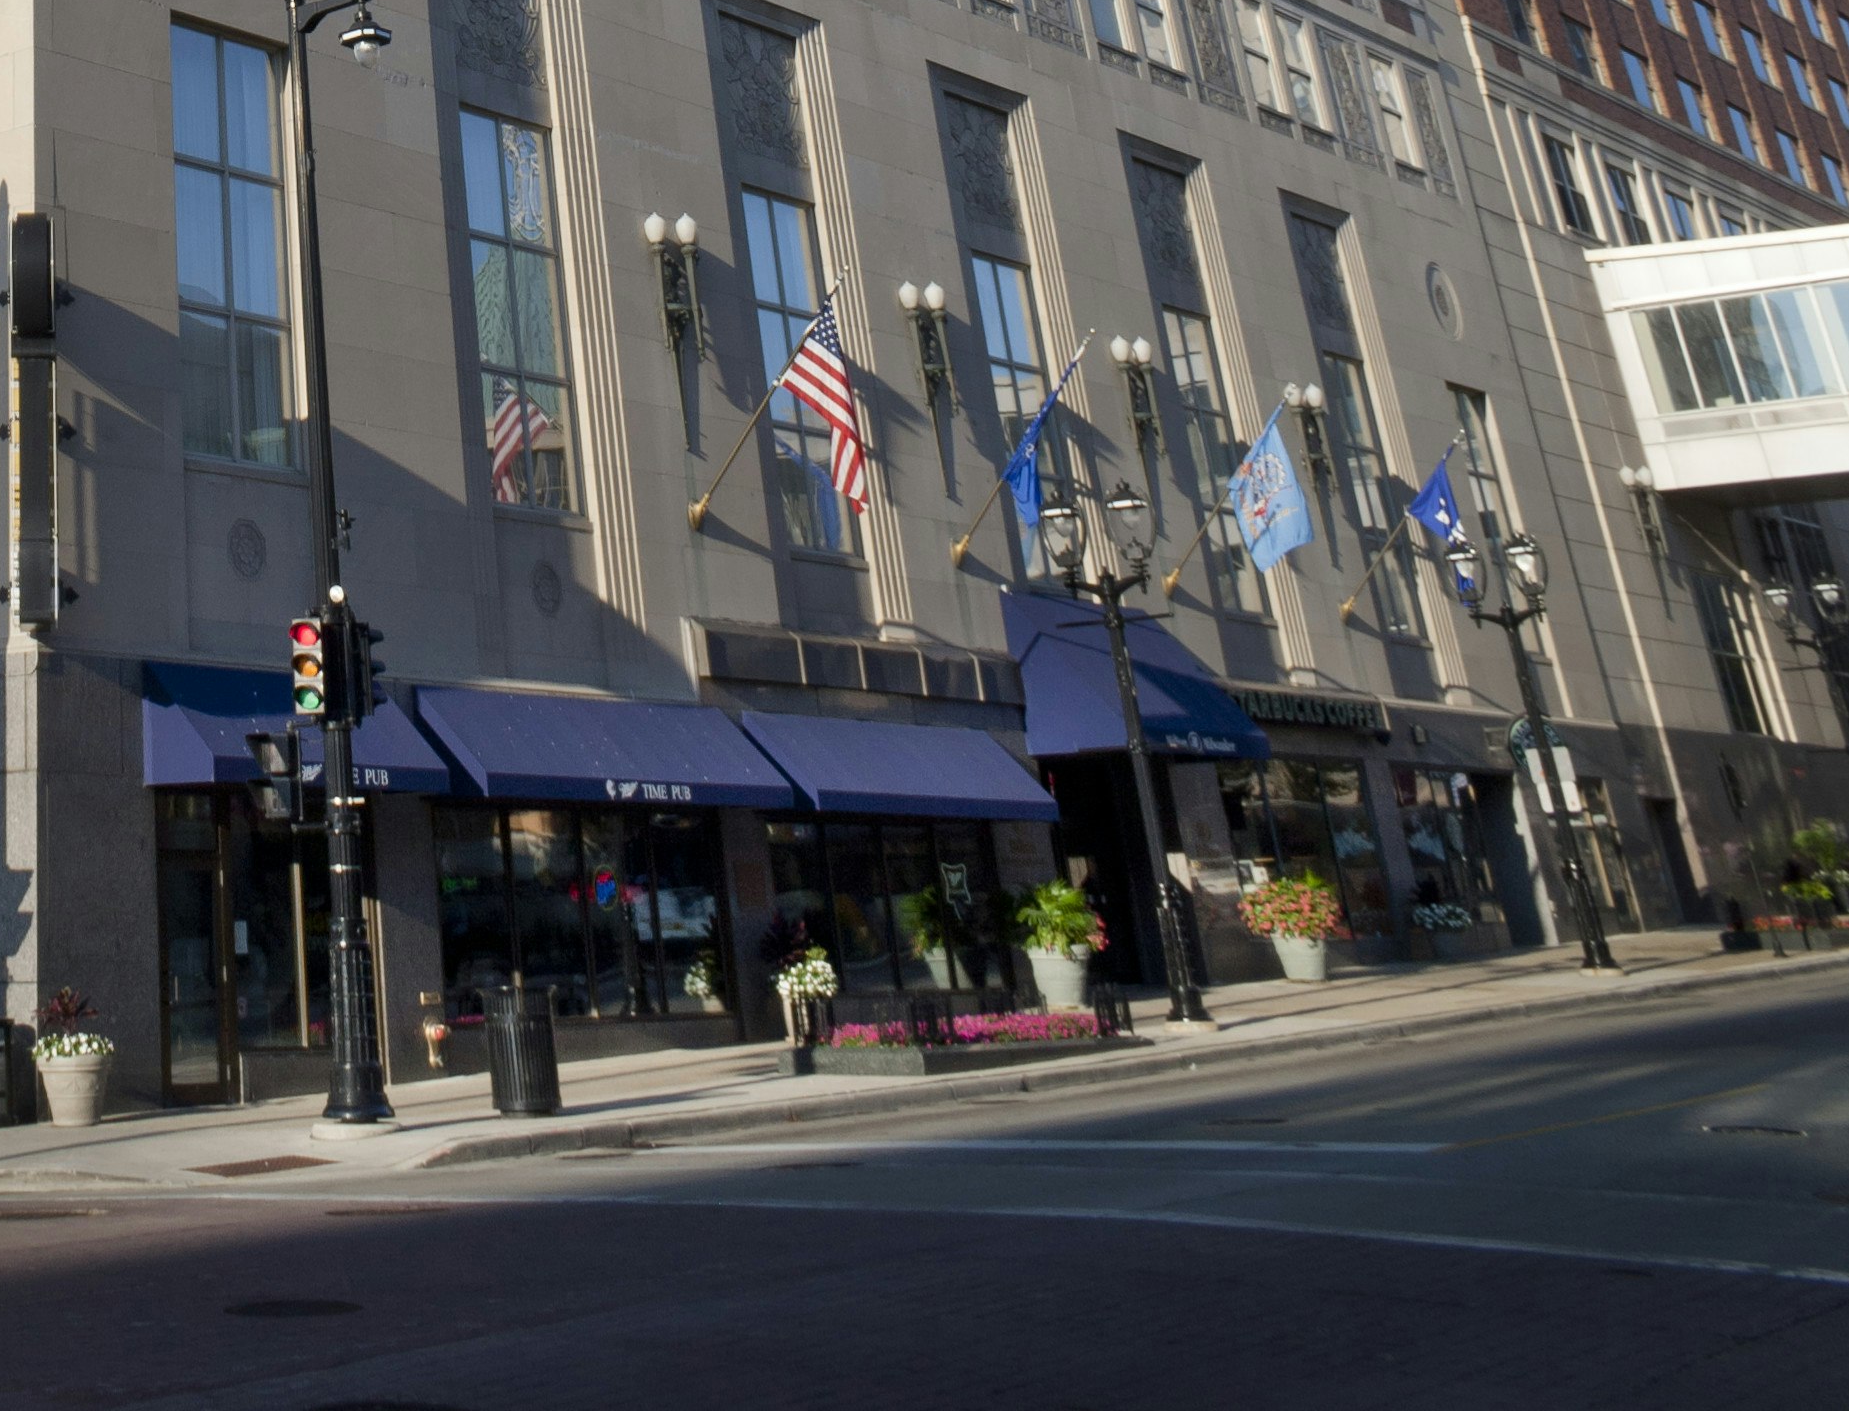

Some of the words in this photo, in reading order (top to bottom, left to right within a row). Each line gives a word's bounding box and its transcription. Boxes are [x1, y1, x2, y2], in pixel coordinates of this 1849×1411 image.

[1234, 691, 1326, 725] TARBUCKS
[365, 768, 389, 786] PUB
[641, 784, 669, 800] TIME
[671, 785, 692, 801] PUB
